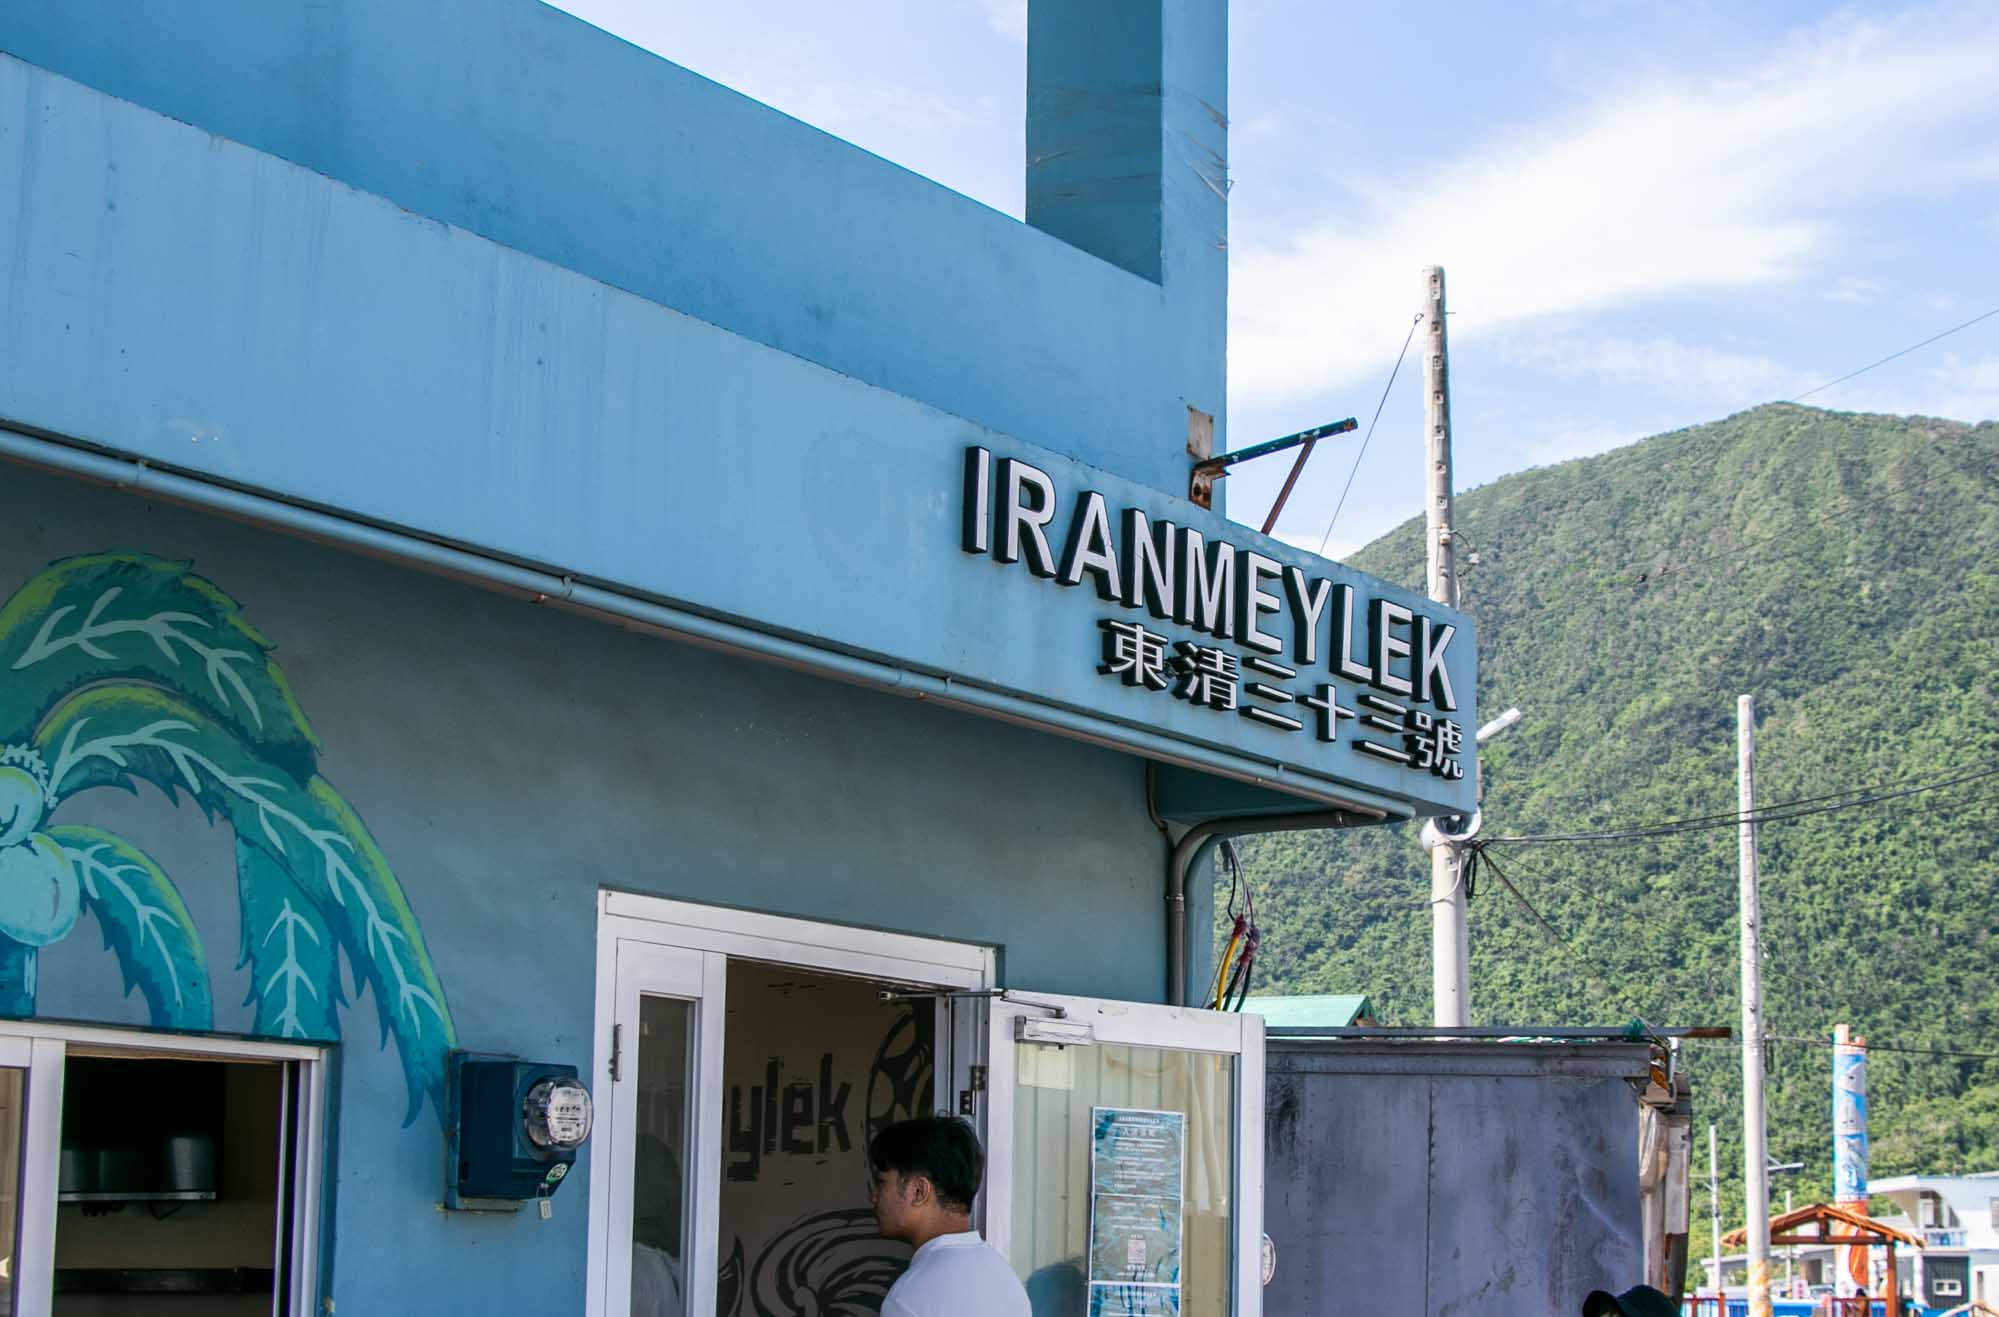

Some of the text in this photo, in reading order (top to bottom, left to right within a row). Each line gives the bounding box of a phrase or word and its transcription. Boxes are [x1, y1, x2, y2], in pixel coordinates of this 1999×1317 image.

[964, 446, 1457, 711] IRANMEYLEK
[1098, 618, 1464, 780] 東清三十三號
[722, 1053, 854, 1182] ylek
